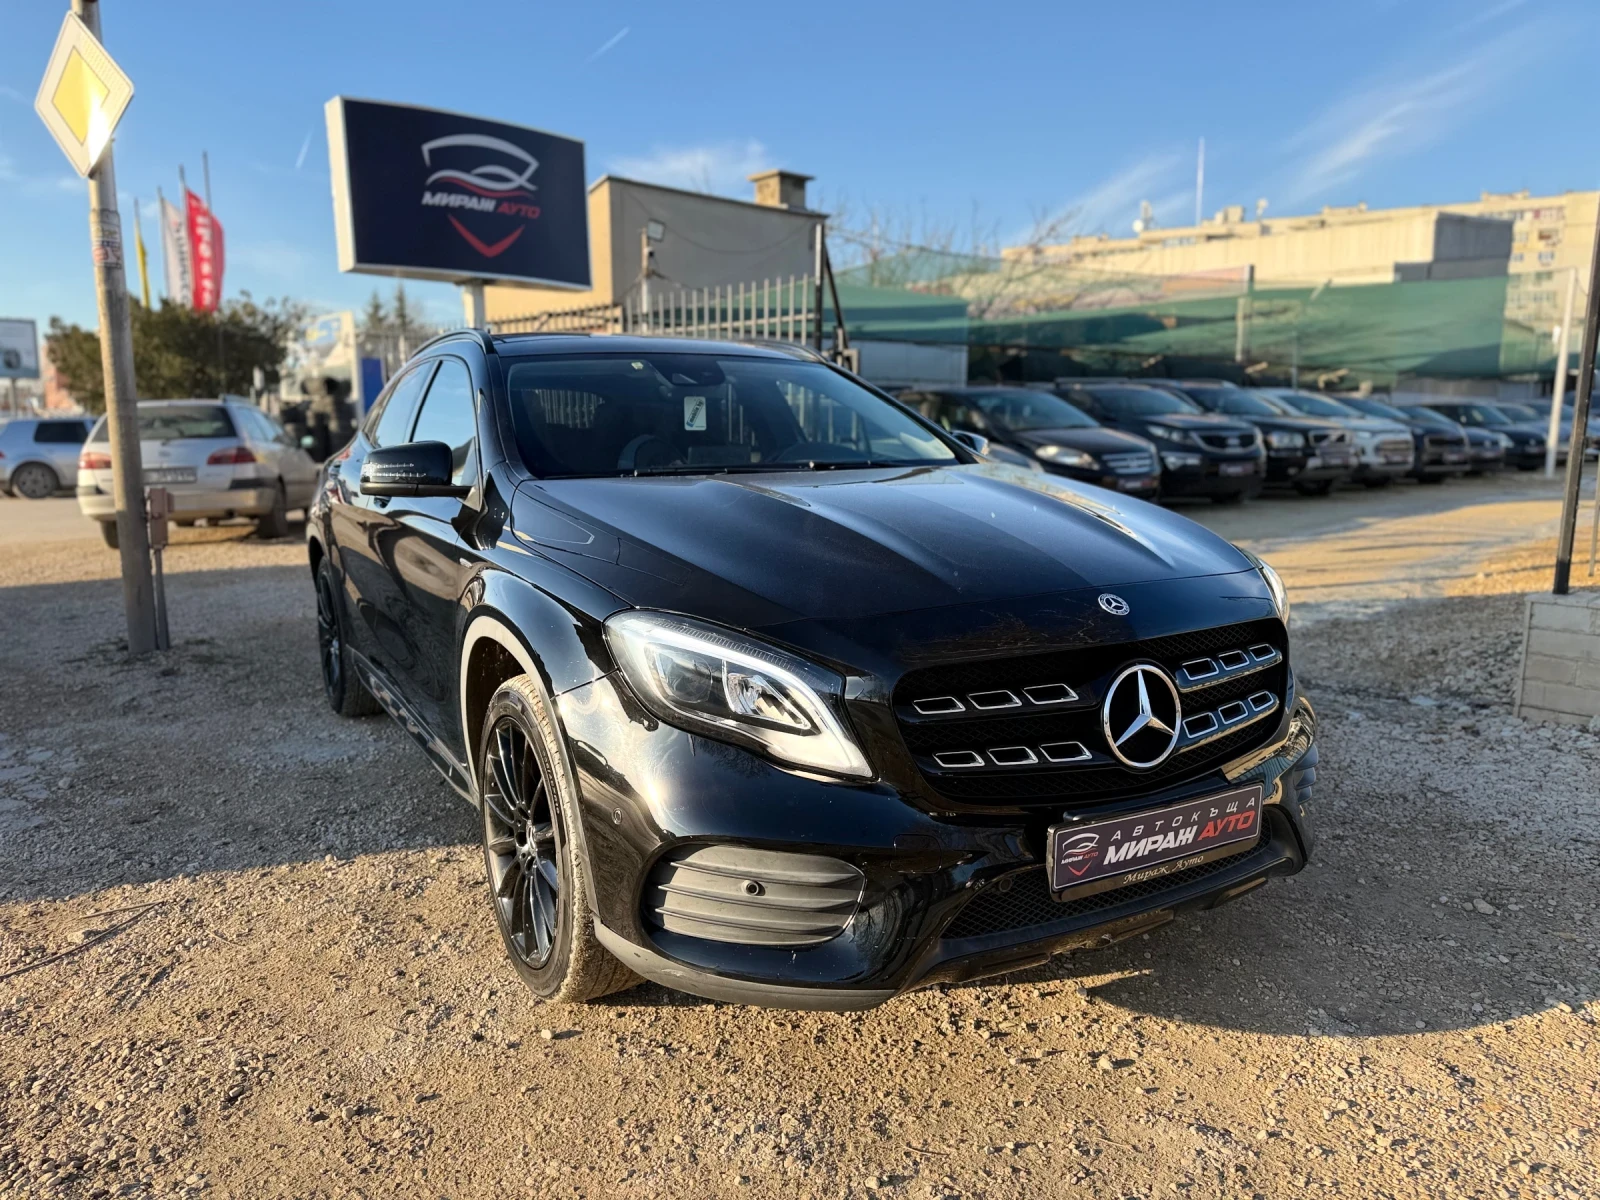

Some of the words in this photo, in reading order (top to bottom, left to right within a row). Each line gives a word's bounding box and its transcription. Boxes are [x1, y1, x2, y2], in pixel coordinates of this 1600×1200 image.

[421, 190, 497, 213] МИРАЖ
[496, 200, 541, 220] АУТО
[1102, 825, 1199, 866] МИРАЖ
[1197, 810, 1255, 841] АУТО
[1122, 864, 1172, 885] Мираж
[1175, 855, 1205, 872] Ауто
